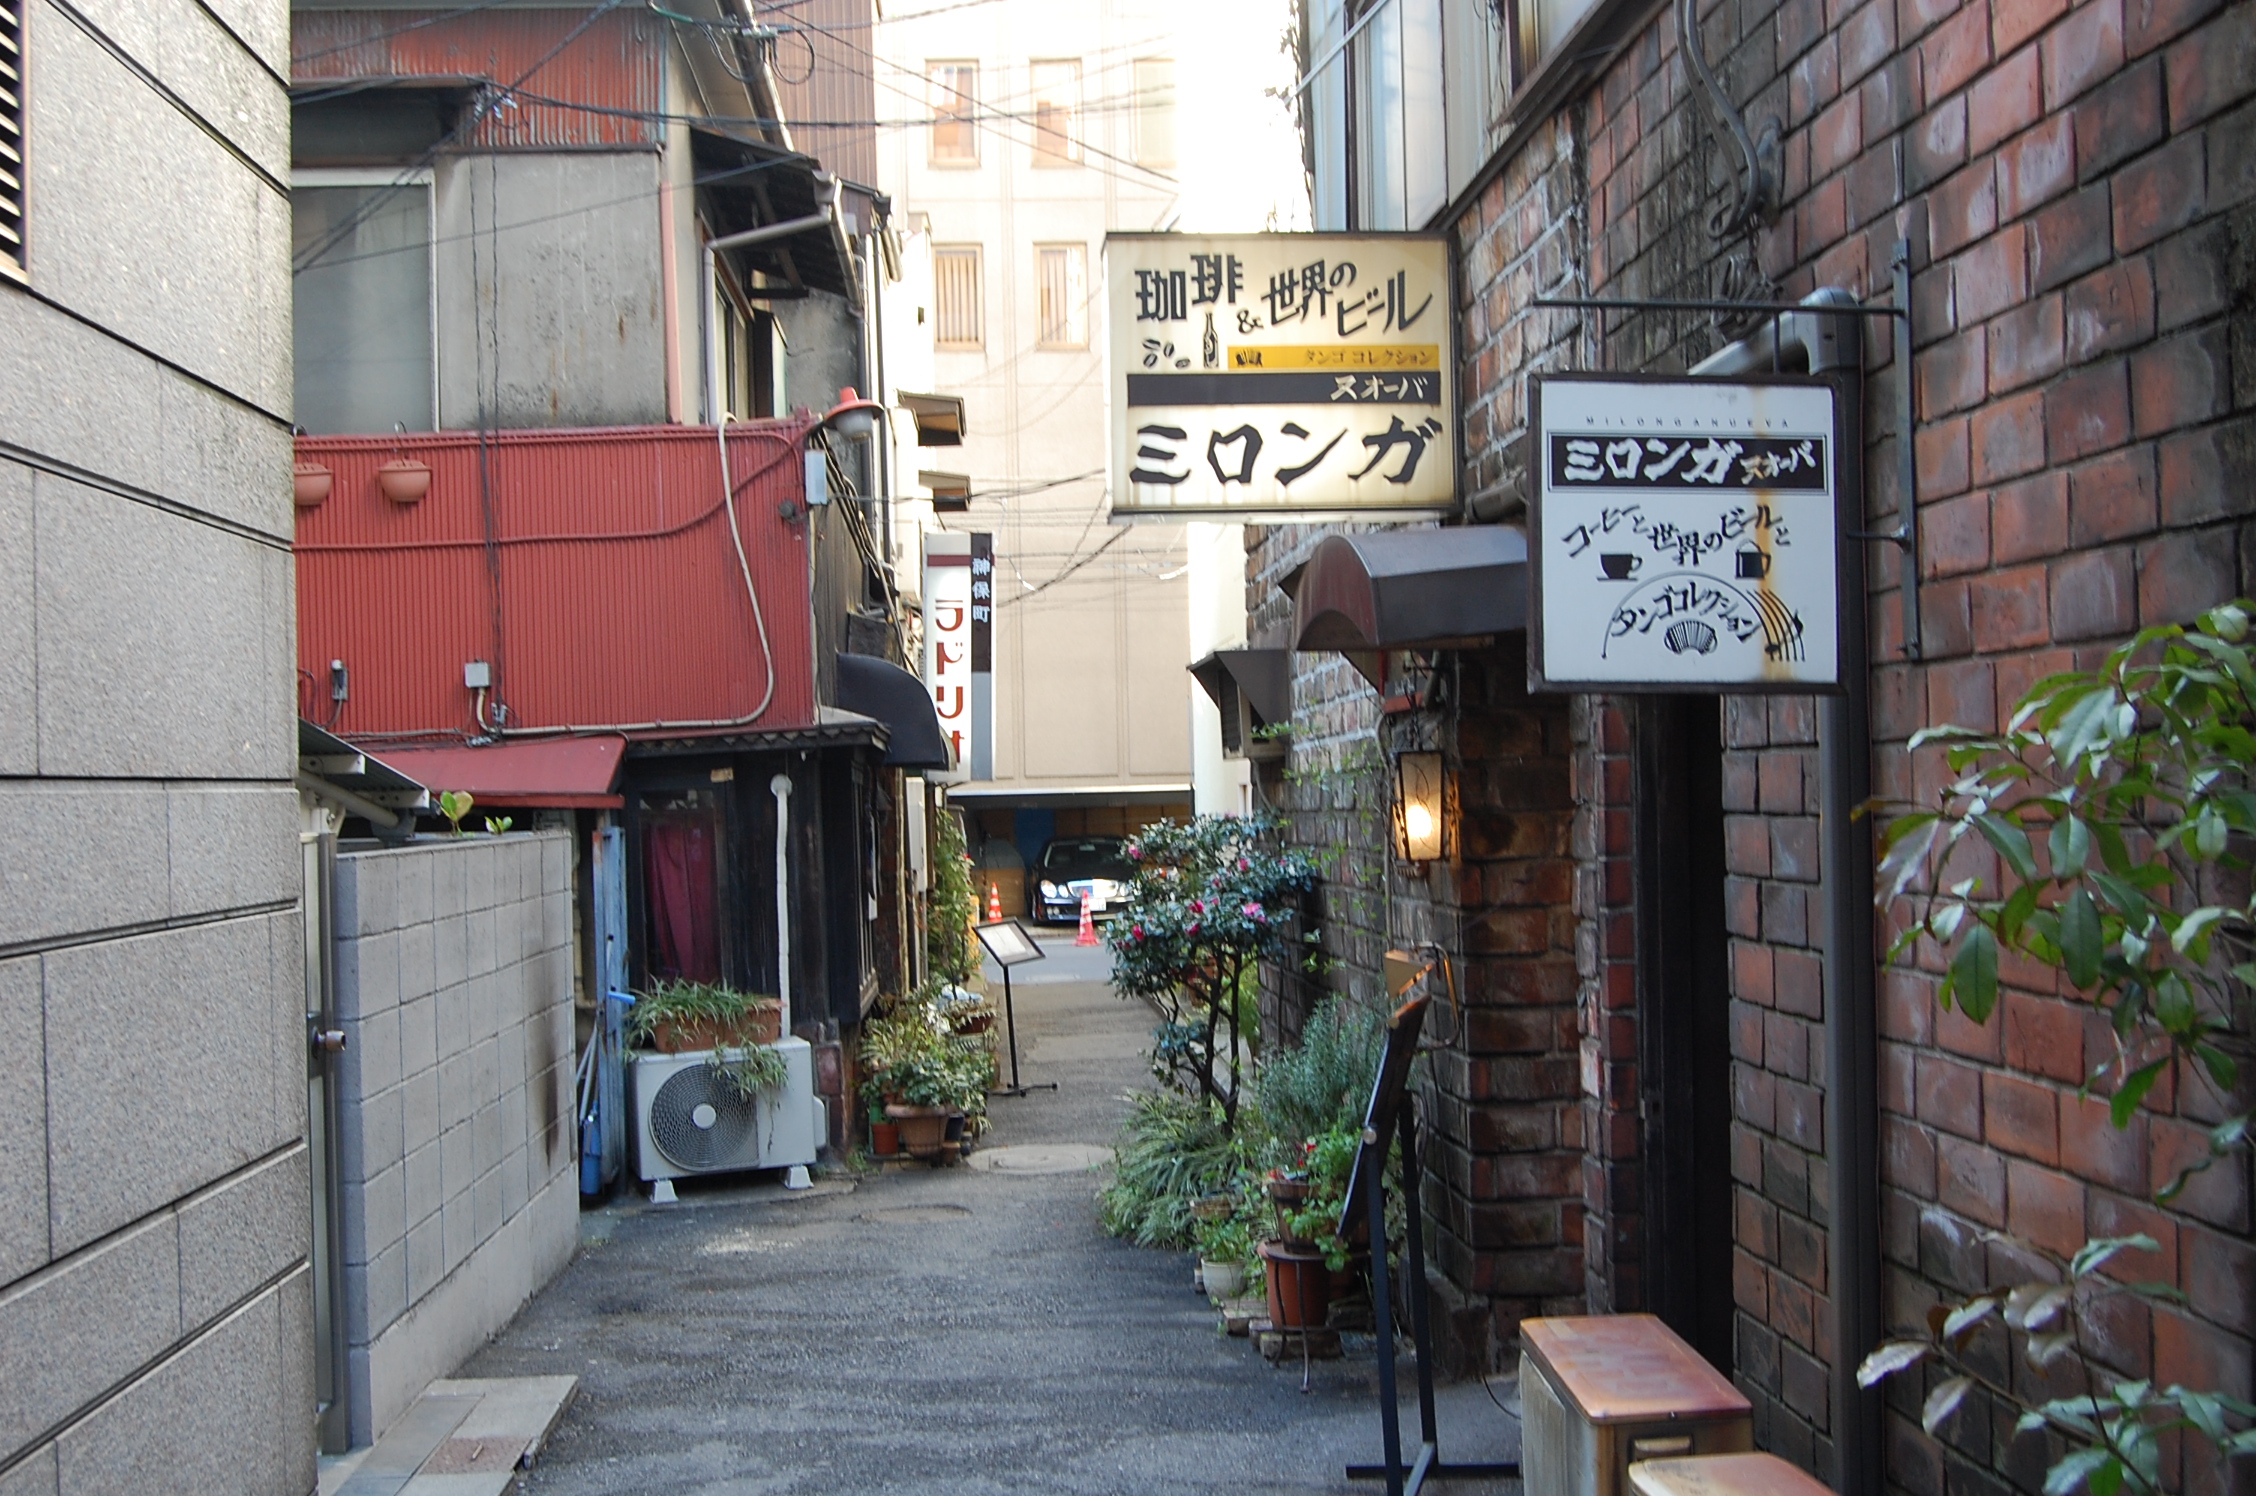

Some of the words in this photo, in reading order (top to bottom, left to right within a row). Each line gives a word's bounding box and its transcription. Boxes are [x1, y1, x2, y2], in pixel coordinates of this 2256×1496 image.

[1129, 414, 1443, 487] ミロンガ
[1564, 437, 1744, 484] ミロンガ
